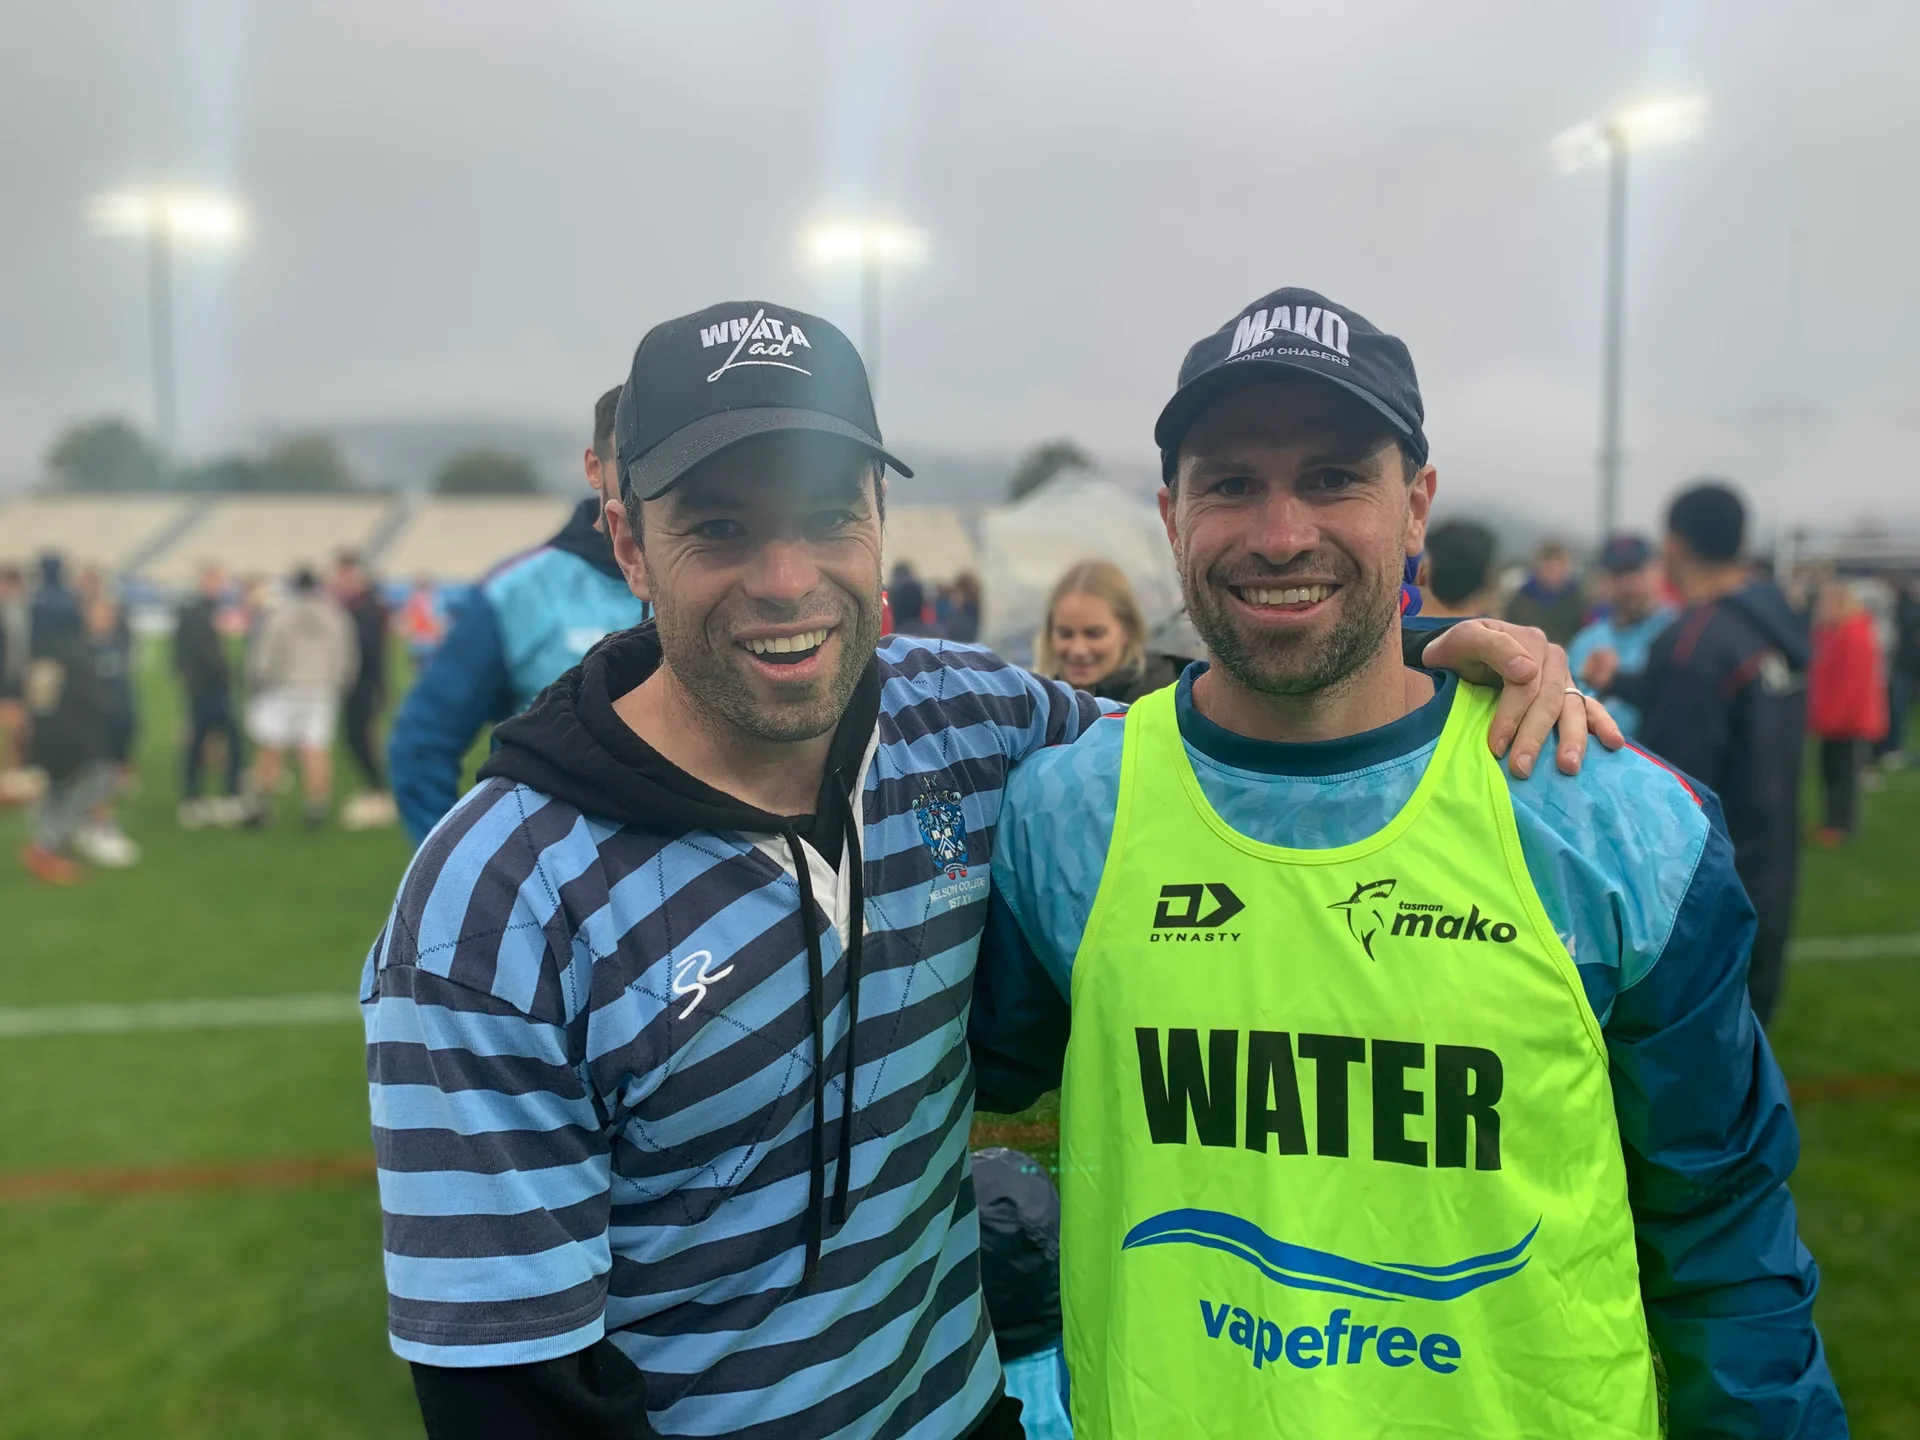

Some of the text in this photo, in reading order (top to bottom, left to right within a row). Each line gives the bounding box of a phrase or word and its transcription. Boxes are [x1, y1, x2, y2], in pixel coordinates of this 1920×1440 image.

[700, 317, 812, 349] WHAT A
[707, 308, 812, 382] Lad
[1225, 305, 1351, 361] MAKO
[1225, 347, 1350, 367] ORM CHASERS
[929, 884, 958, 904] NELSON
[1398, 901, 1443, 912] tasman
[1150, 932, 1242, 943] DYNASTY
[1390, 903, 1518, 943] mako
[1134, 1027, 1504, 1171] WATER
[1199, 1299, 1462, 1374] vapefree
